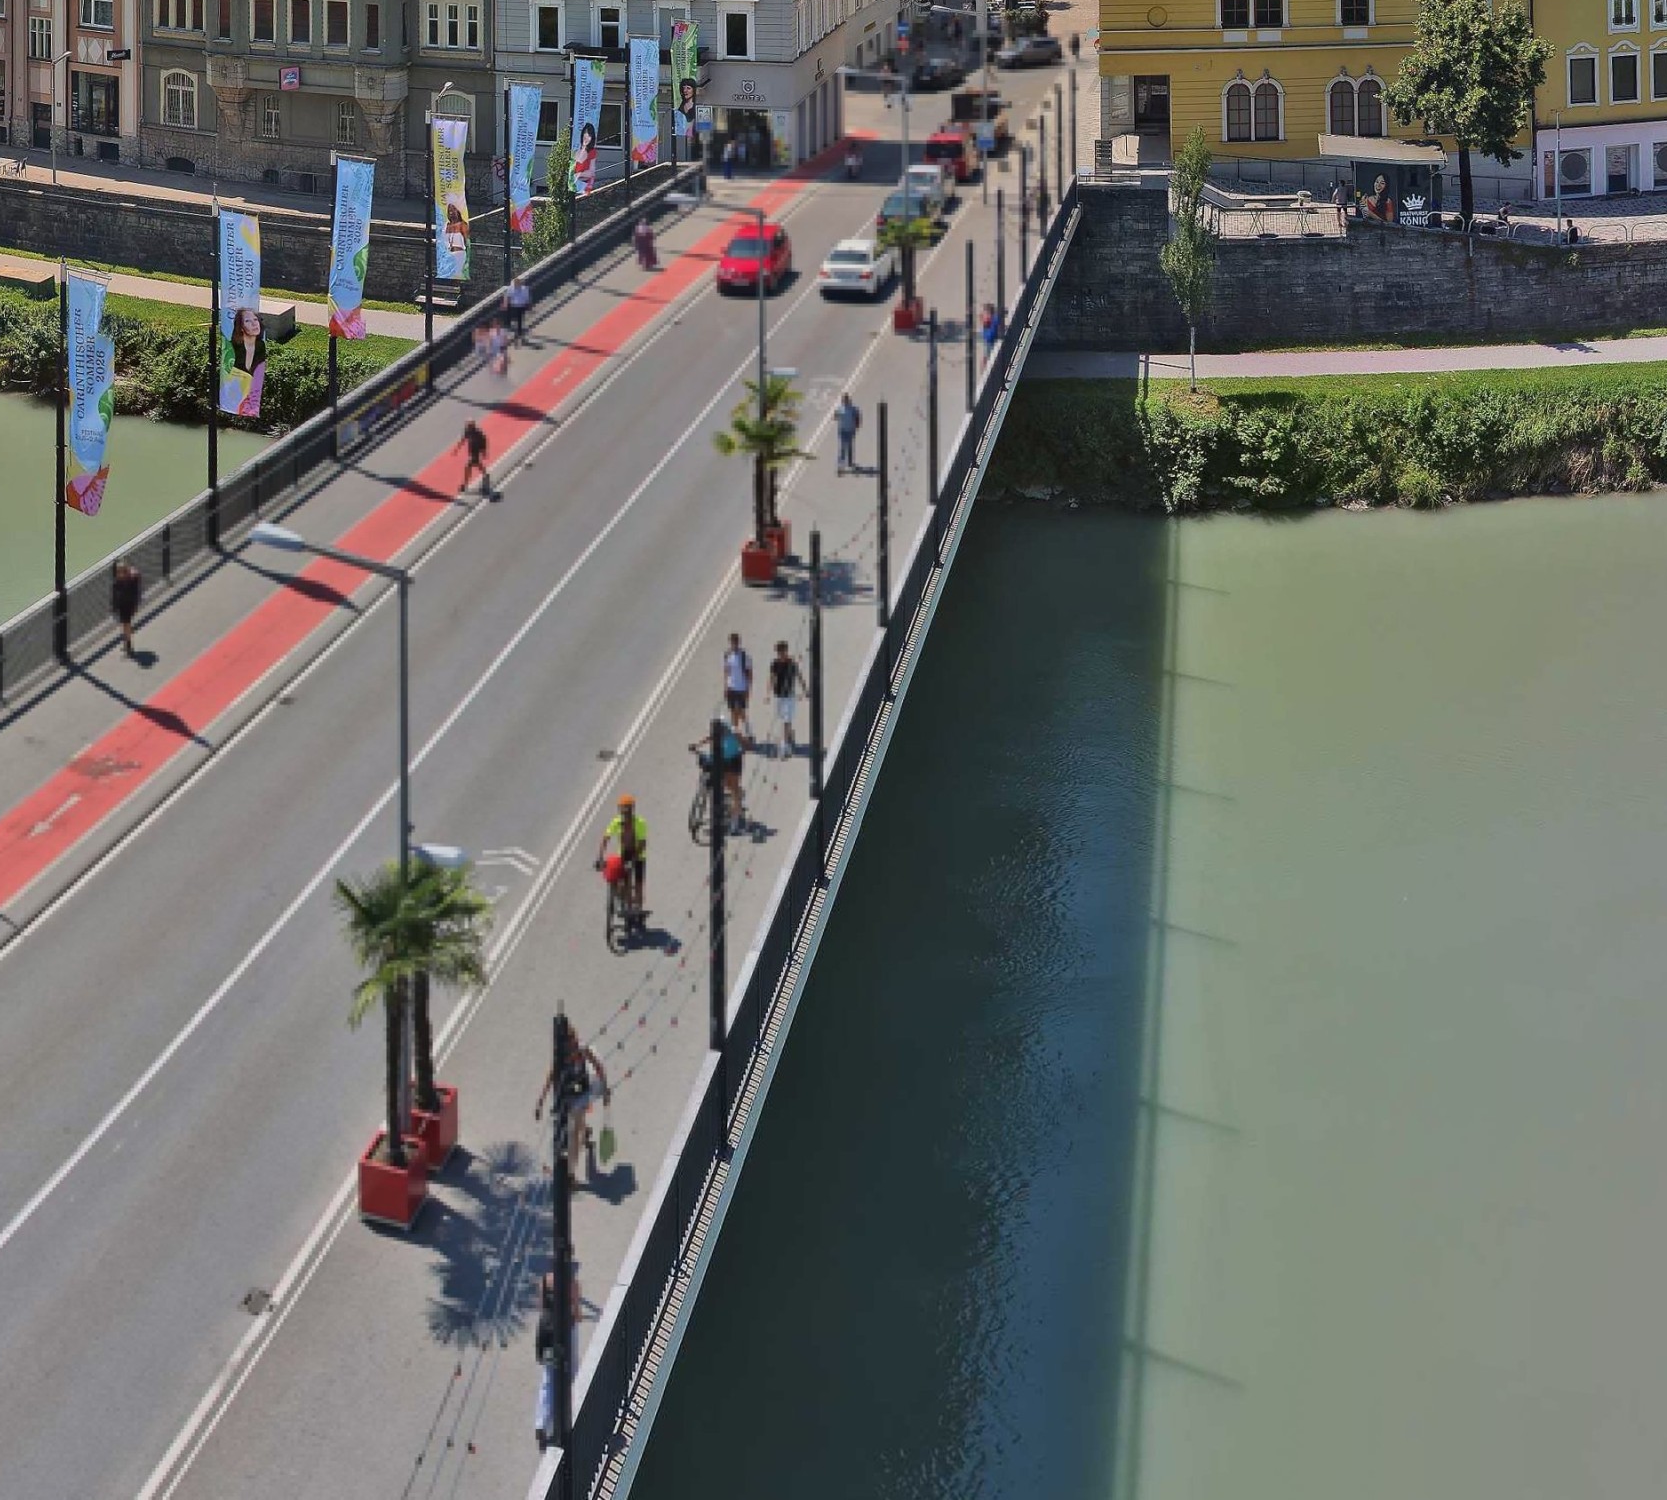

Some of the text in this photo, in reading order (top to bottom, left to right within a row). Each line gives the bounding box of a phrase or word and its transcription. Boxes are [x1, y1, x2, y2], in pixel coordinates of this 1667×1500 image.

[579, 66, 588, 132] CARINTHISCHER
[438, 127, 447, 206] CARINTHISCHER
[514, 104, 524, 175] CARINTHISCHER
[336, 185, 350, 271] CARINTHISCHER
[346, 206, 357, 253] SOMMER
[353, 218, 363, 244] 2026
[226, 222, 237, 320] CARINTHISCHER
[236, 247, 244, 299] SOMMER
[245, 259, 254, 288] 2026
[75, 307, 86, 420] CARINTHISCHER
[85, 335, 95, 395] SOMMER
[96, 349, 106, 383] 2026
